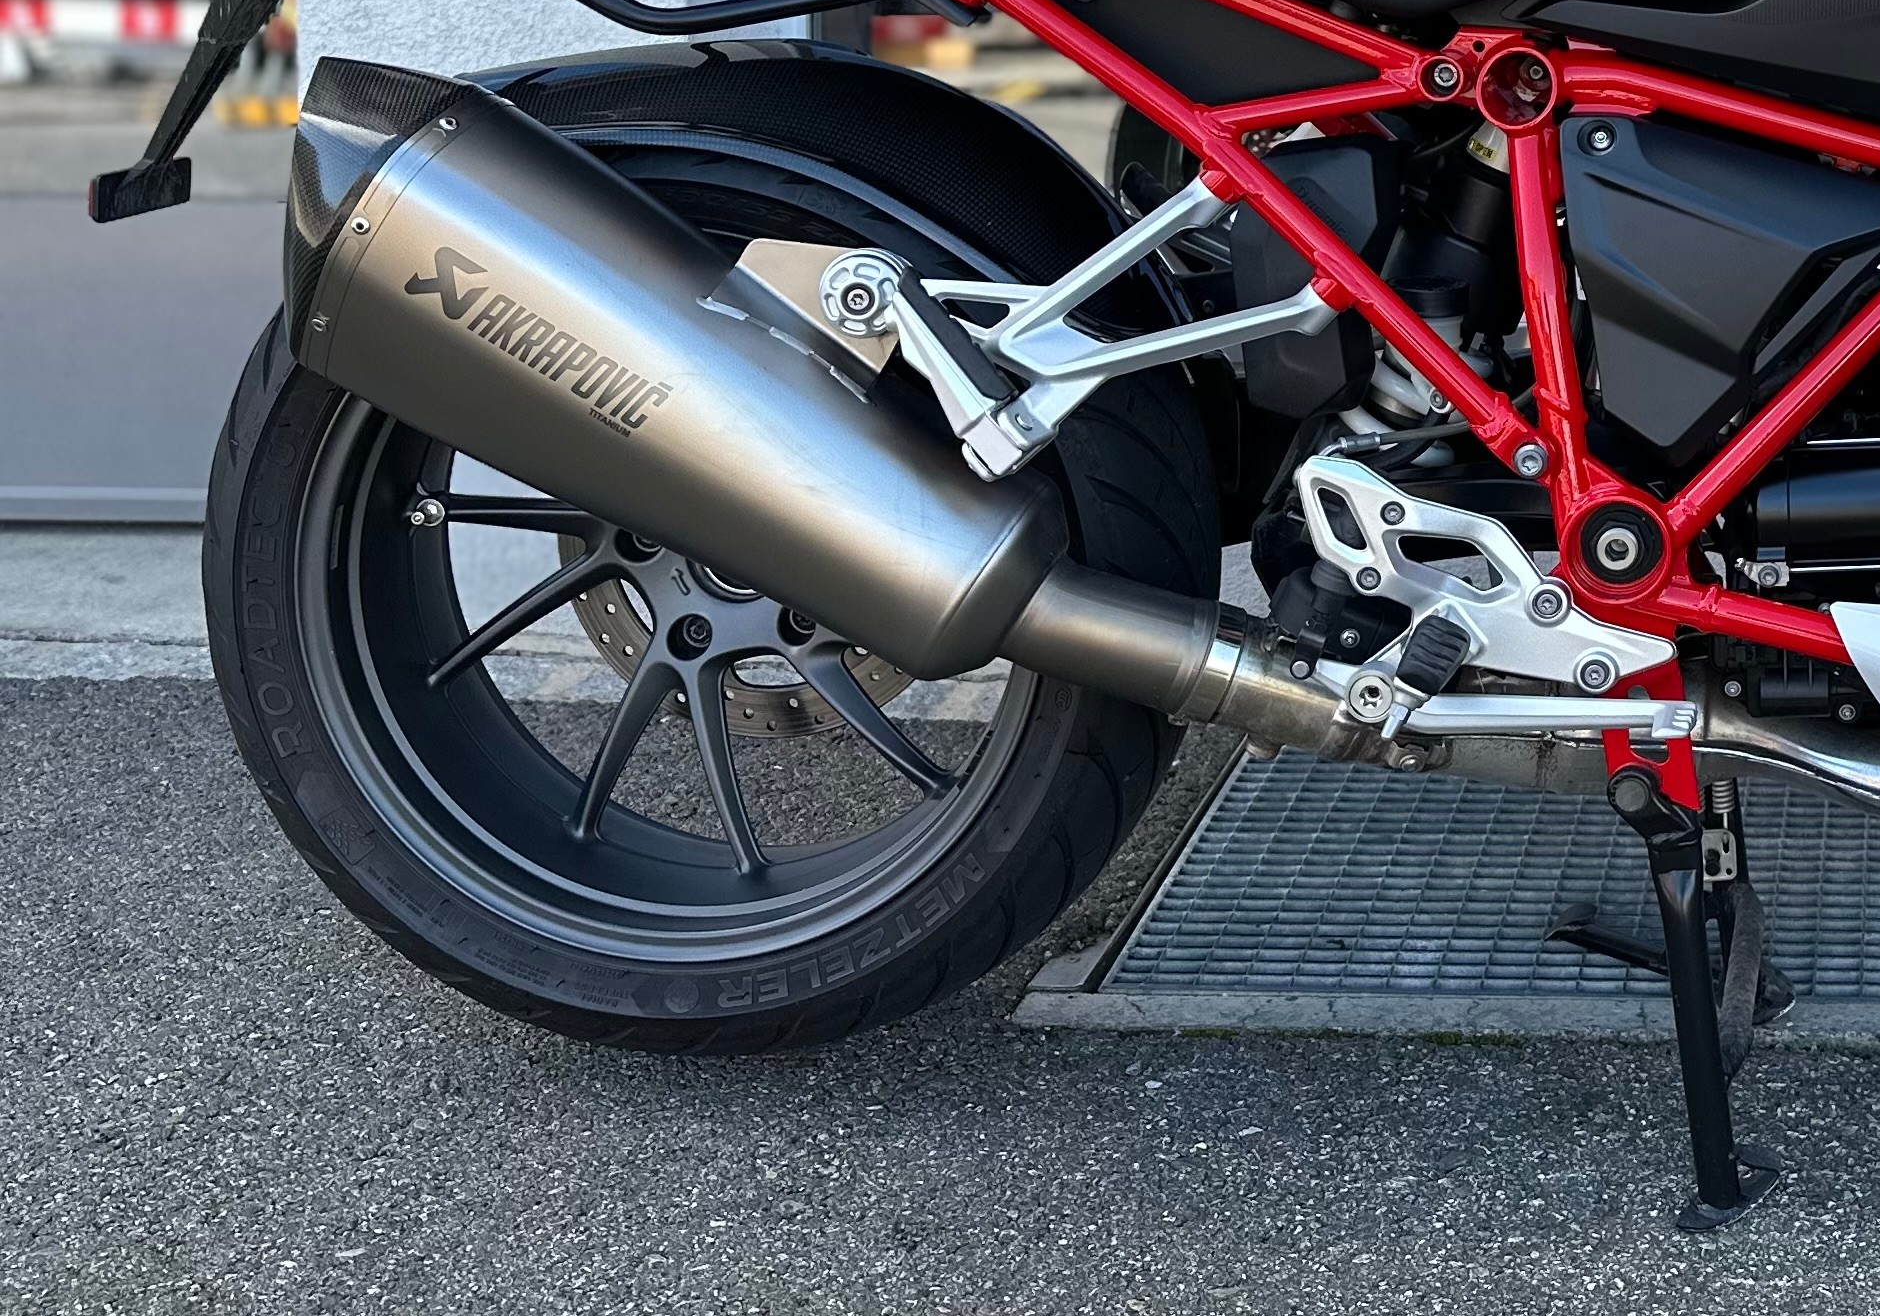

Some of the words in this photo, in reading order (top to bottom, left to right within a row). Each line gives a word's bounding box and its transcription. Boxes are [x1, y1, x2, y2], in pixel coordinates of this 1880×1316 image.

[588, 406, 632, 439] TITANIUM
[241, 497, 313, 760] ROADTEC
[717, 851, 986, 1009] METZELER
